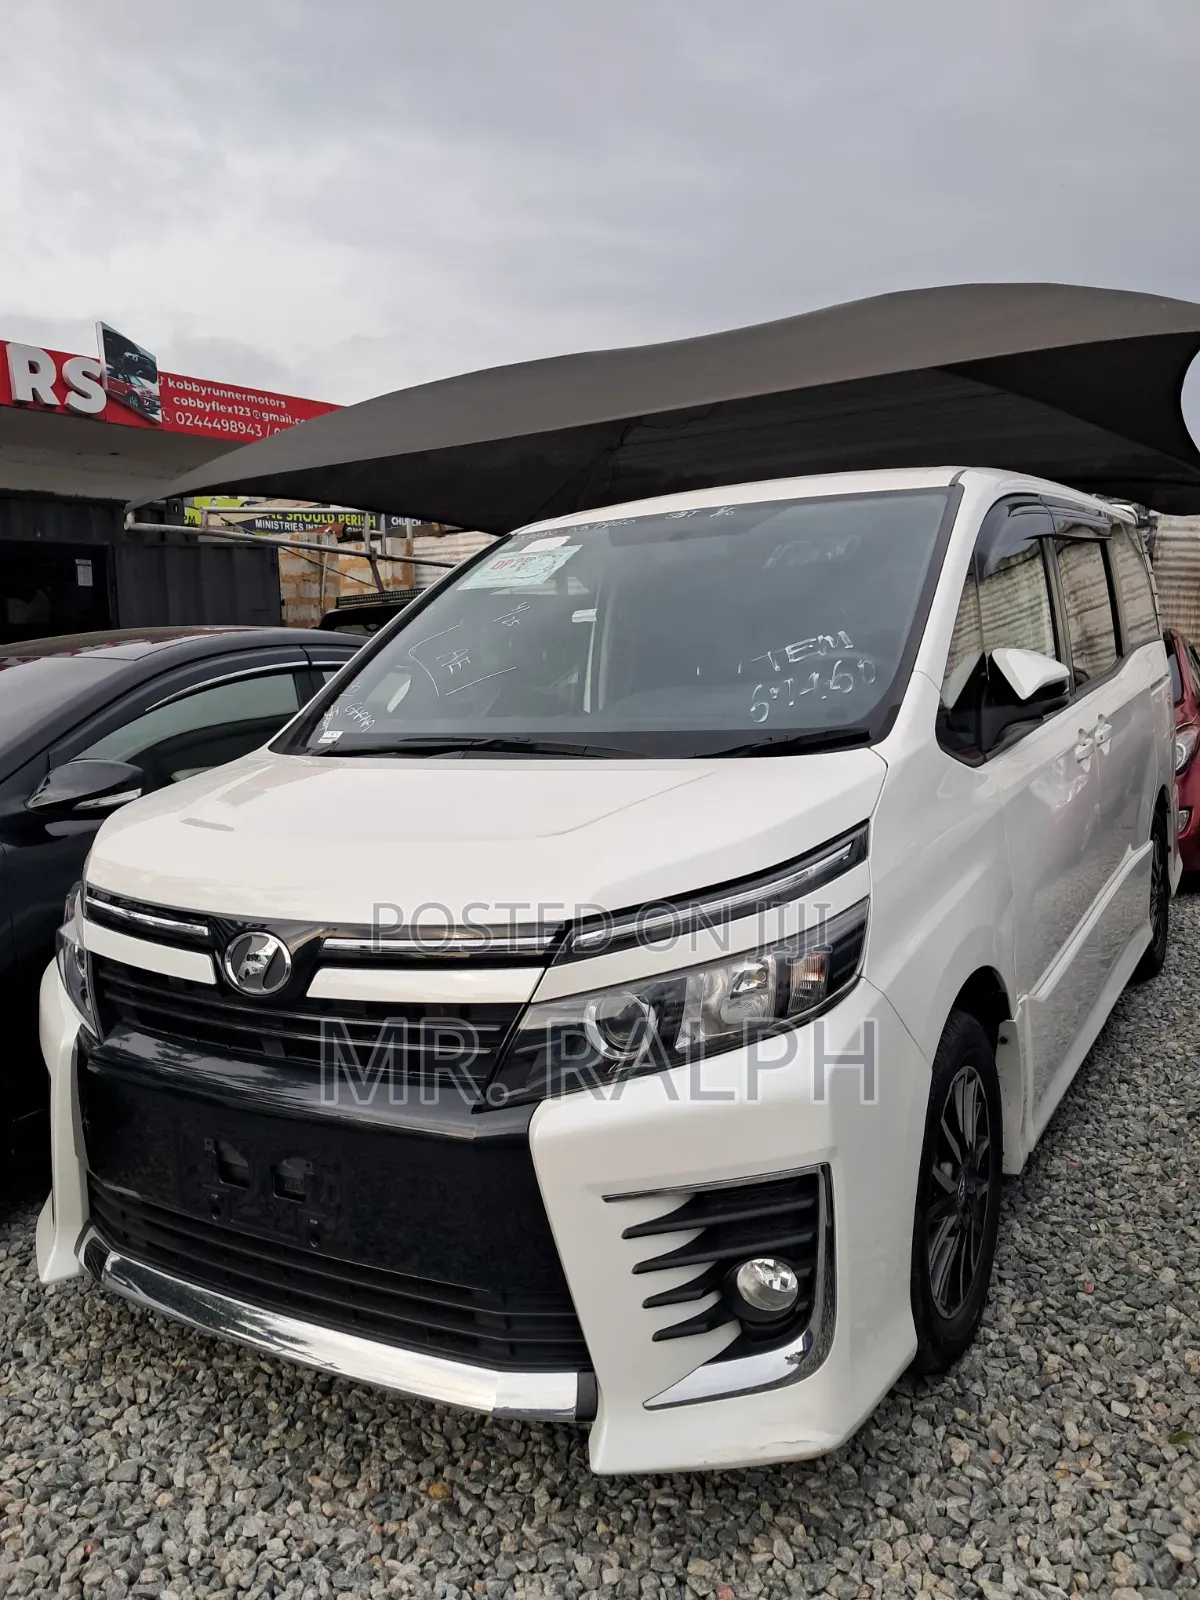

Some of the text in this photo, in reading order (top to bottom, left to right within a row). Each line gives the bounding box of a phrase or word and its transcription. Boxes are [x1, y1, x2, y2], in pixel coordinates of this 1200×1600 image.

[6, 342, 107, 415] RS
[167, 377, 286, 409] kobbyrunnermotors
[175, 411, 263, 437] 0244498943
[255, 519, 304, 531] MINISTRIES
[391, 516, 422, 526] CHUCH
